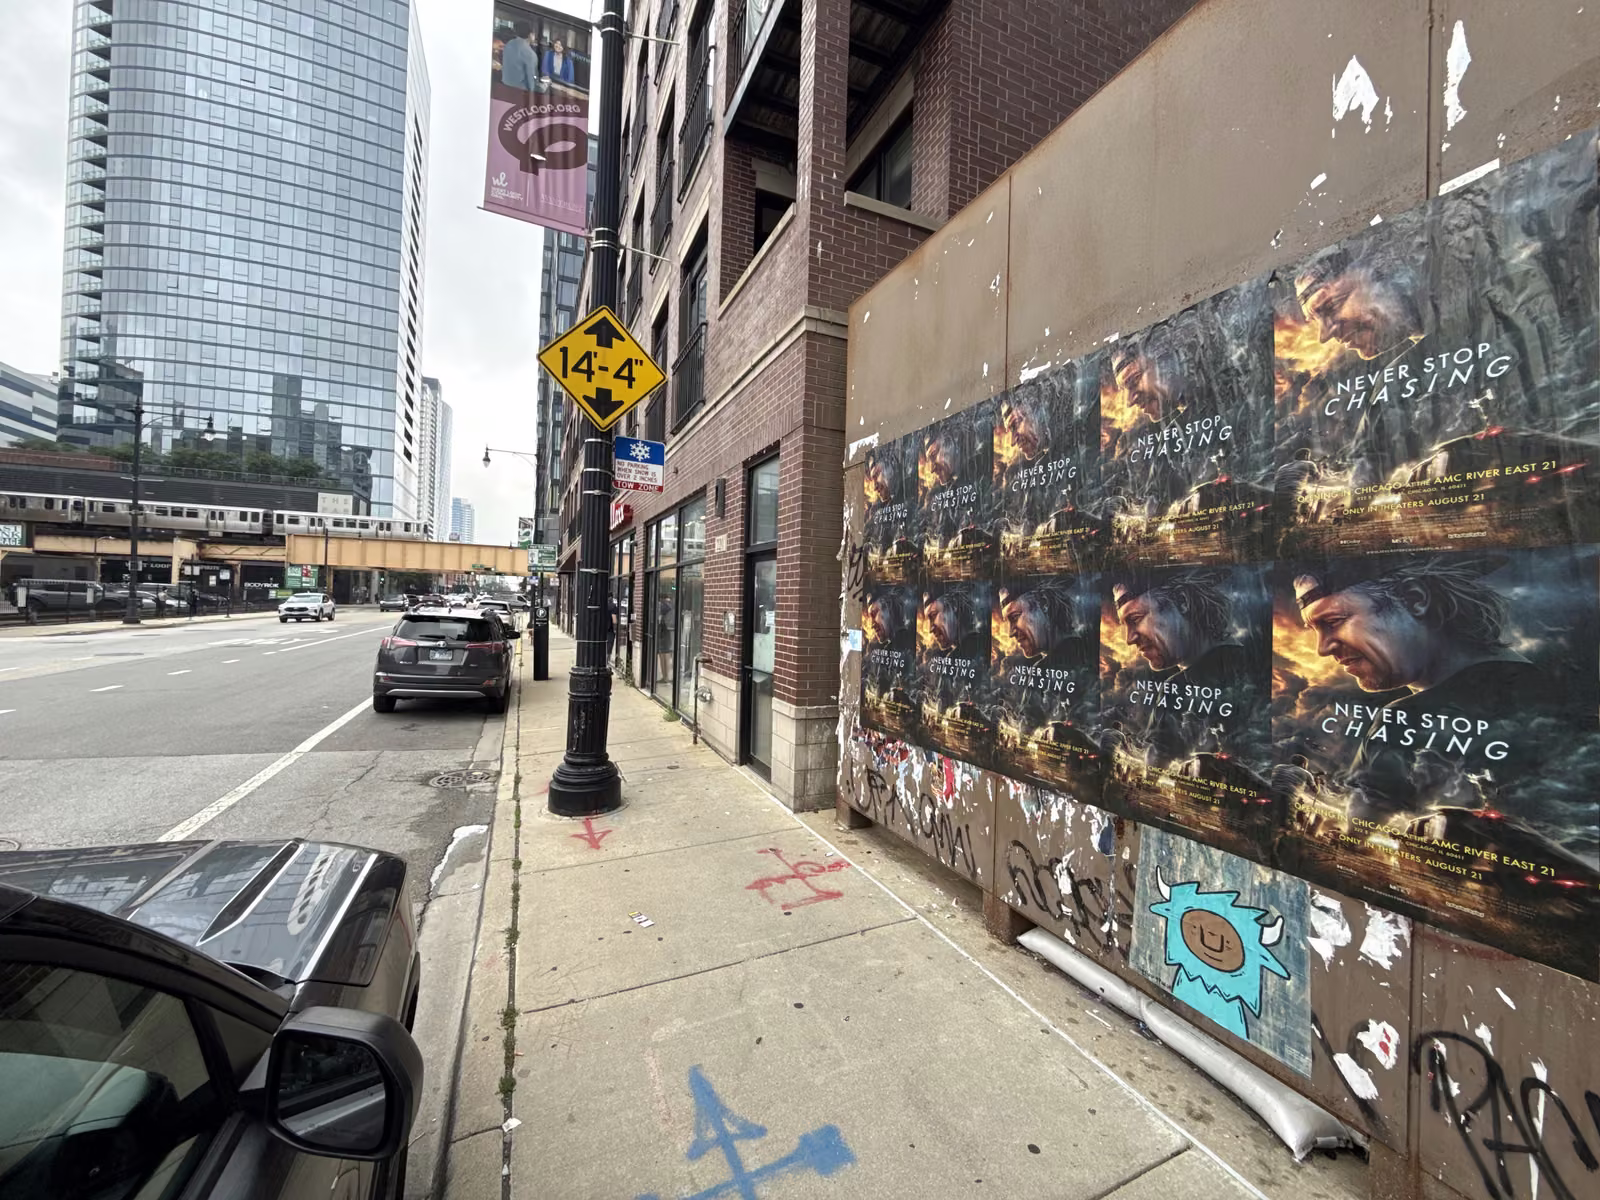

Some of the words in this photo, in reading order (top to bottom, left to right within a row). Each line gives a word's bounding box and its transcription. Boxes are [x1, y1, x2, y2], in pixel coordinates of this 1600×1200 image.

[503, 103, 581, 132] WESTLOOP.ORG
[1337, 363, 1409, 396] NEVER
[1423, 342, 1490, 373] STOP
[1325, 355, 1512, 417] CHASING
[1137, 427, 1179, 448] NEVER
[1185, 415, 1221, 435] STOP
[1130, 425, 1233, 463] CHASING
[627, 462, 649, 470] PARKING
[1018, 465, 1044, 479] NEVER
[1048, 457, 1070, 471] STOP
[616, 480, 634, 489] TOW
[638, 483, 659, 492] ZONE
[1012, 466, 1077, 492] CHASING
[1354, 482, 1401, 495] CHICAGO
[1434, 473, 1462, 485] AMC
[1466, 468, 1500, 480] RIVER
[1505, 463, 1537, 475] EAST
[1542, 461, 1556, 470] 21
[931, 492, 977, 512] CHASING
[934, 489, 954, 501] NEVER
[956, 484, 973, 496] STOP
[1229, 502, 1246, 511] EAST
[1343, 507, 1365, 516] ONLY
[1368, 505, 1378, 513] IN
[1381, 500, 1424, 511] THEATERS
[1428, 495, 1469, 506] AUGUST
[1473, 493, 1485, 501] 21
[871, 655, 905, 668] CHASING
[930, 664, 976, 679] CHASING
[931, 656, 952, 666] NEVER
[955, 658, 971, 667] STOP
[1015, 665, 1042, 677] NEVER
[1046, 668, 1069, 680] STOP
[1010, 674, 1076, 693] CHASING
[1137, 680, 1179, 694] NEVER
[1185, 685, 1222, 699] STOP
[1130, 691, 1233, 717] CHASING
[1335, 702, 1408, 725] NEVER
[1421, 713, 1490, 736] STOP
[1321, 717, 1510, 760] CHASING
[1189, 792, 1212, 802] AUGUST
[1210, 781, 1227, 790] RIVER
[1230, 786, 1247, 795] EAST
[1248, 790, 1257, 798] 21
[1339, 835, 1361, 845] ONLY
[1364, 841, 1375, 849] IN
[1376, 843, 1421, 863] THEATERS
[1425, 858, 1467, 876] AUGUST
[1471, 871, 1483, 881] 21
[1351, 817, 1400, 835] CHICAGO
[1432, 839, 1461, 852] AMC
[1464, 846, 1498, 862] RIVER
[1503, 856, 1536, 872] EAST
[1540, 865, 1555, 877] 21
